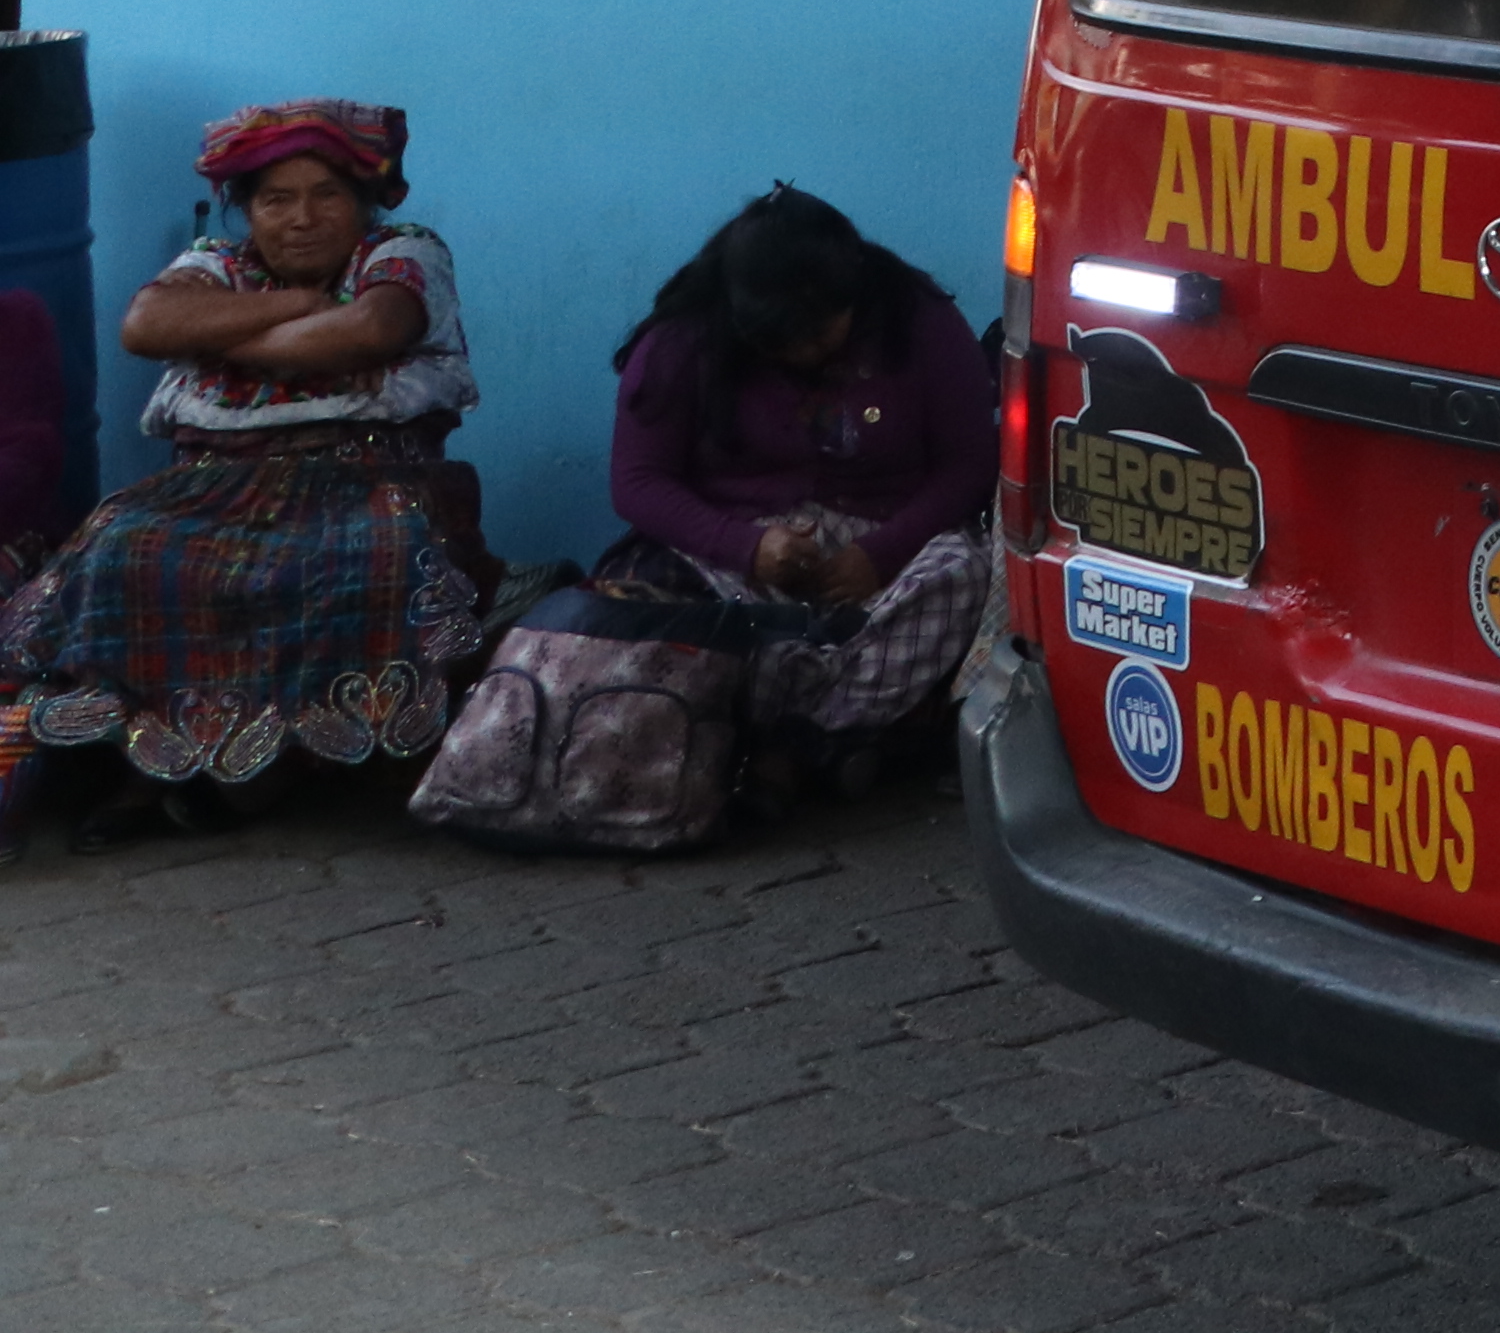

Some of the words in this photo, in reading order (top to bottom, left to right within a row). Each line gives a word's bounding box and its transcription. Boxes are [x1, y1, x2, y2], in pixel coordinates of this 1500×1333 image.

[1057, 427, 1253, 529] HEROES
[1088, 496, 1252, 577] SIEMPRE
[1081, 570, 1166, 618] Super
[1076, 600, 1177, 654] Market
[1125, 695, 1158, 716] salas
[1119, 708, 1168, 758] VIP
[1195, 683, 1476, 894] BOMBEROS
